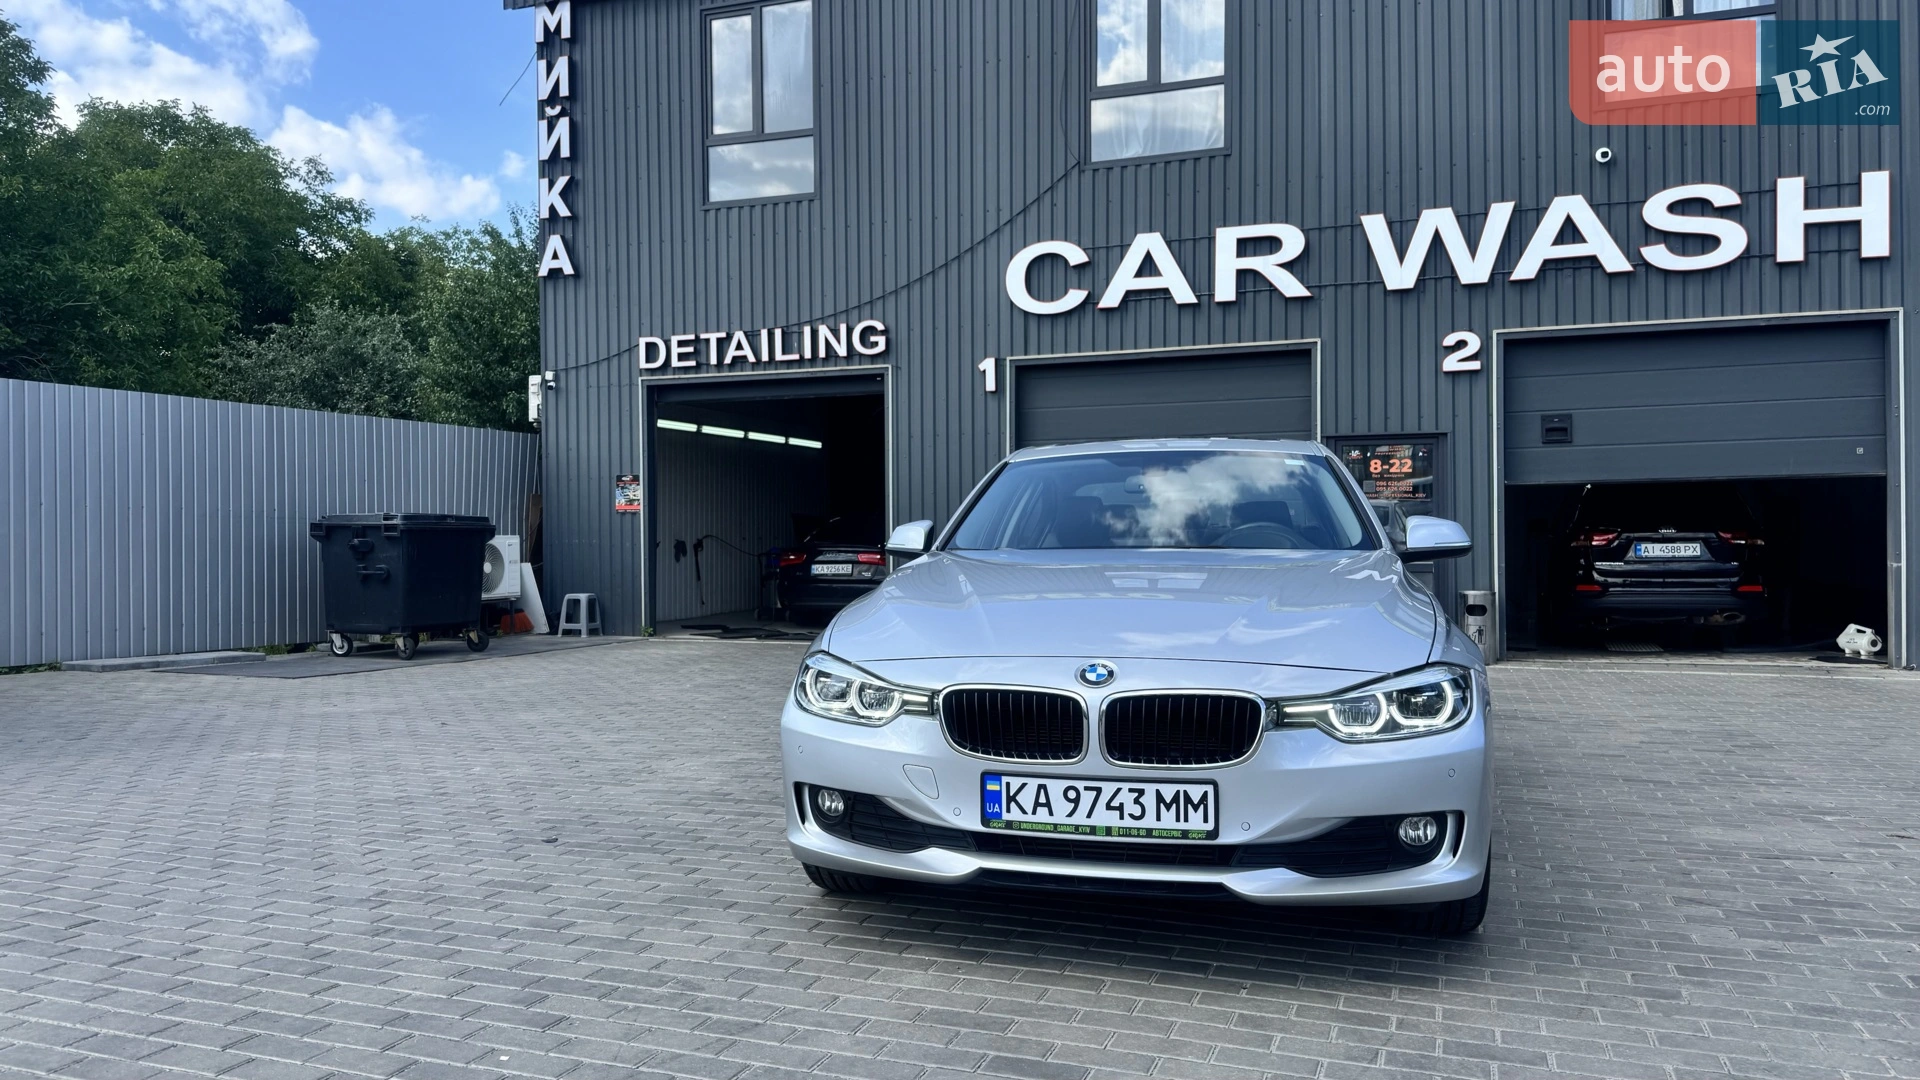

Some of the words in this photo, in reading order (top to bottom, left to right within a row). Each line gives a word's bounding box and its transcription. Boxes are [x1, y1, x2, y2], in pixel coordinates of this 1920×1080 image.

[535, 0, 575, 277] МИЙКА
[1005, 222, 1312, 315] CAR
[1360, 170, 1892, 291] WASH
[638, 319, 888, 369] DETAILING
[1441, 331, 1483, 373] 2
[977, 357, 997, 393] 1
[1369, 458, 1413, 473] 8-22
[826, 565, 840, 573] 9256
[841, 565, 851, 573] KE
[1643, 546, 1655, 554] AI
[1659, 545, 1682, 554] 4588
[1684, 545, 1698, 554] PX
[986, 802, 1001, 814] UA
[1005, 781, 1054, 817] KA
[1062, 785, 1146, 821] 9743
[1155, 788, 1208, 824] MM
